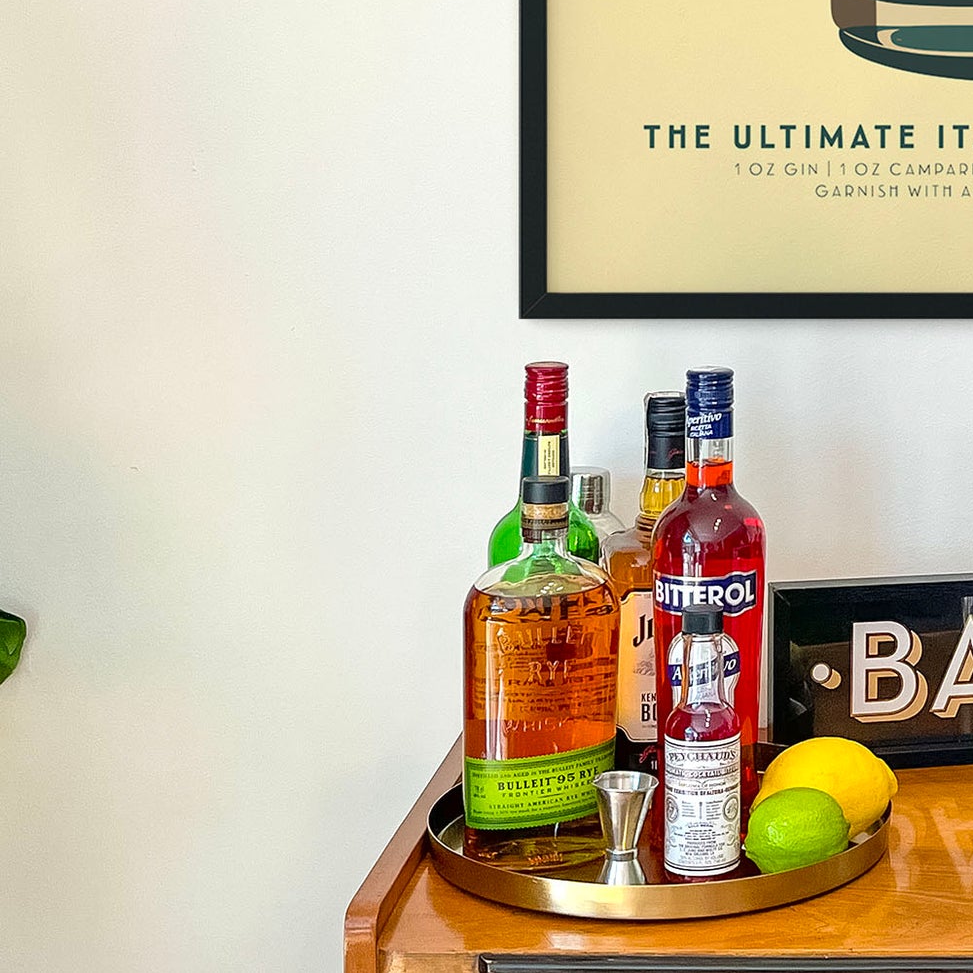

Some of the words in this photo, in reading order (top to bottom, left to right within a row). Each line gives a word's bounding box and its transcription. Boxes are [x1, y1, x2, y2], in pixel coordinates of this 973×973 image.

[643, 124, 711, 149] THE
[734, 124, 915, 150] ULTIMATE
[734, 162, 741, 176] 1
[748, 162, 775, 177] OZ
[784, 162, 818, 177] GIN
[839, 162, 846, 176] 1
[854, 162, 880, 177] OZ
[814, 184, 899, 199] GARNISH
[907, 184, 952, 198] WITH
[655, 579, 755, 608] BITTEROL
[497, 777, 551, 792] BULLEIT
[556, 771, 576, 785] 95
[579, 765, 600, 780] RYE
[502, 786, 553, 799] FRONTIER
[556, 779, 593, 792] WHISKE
